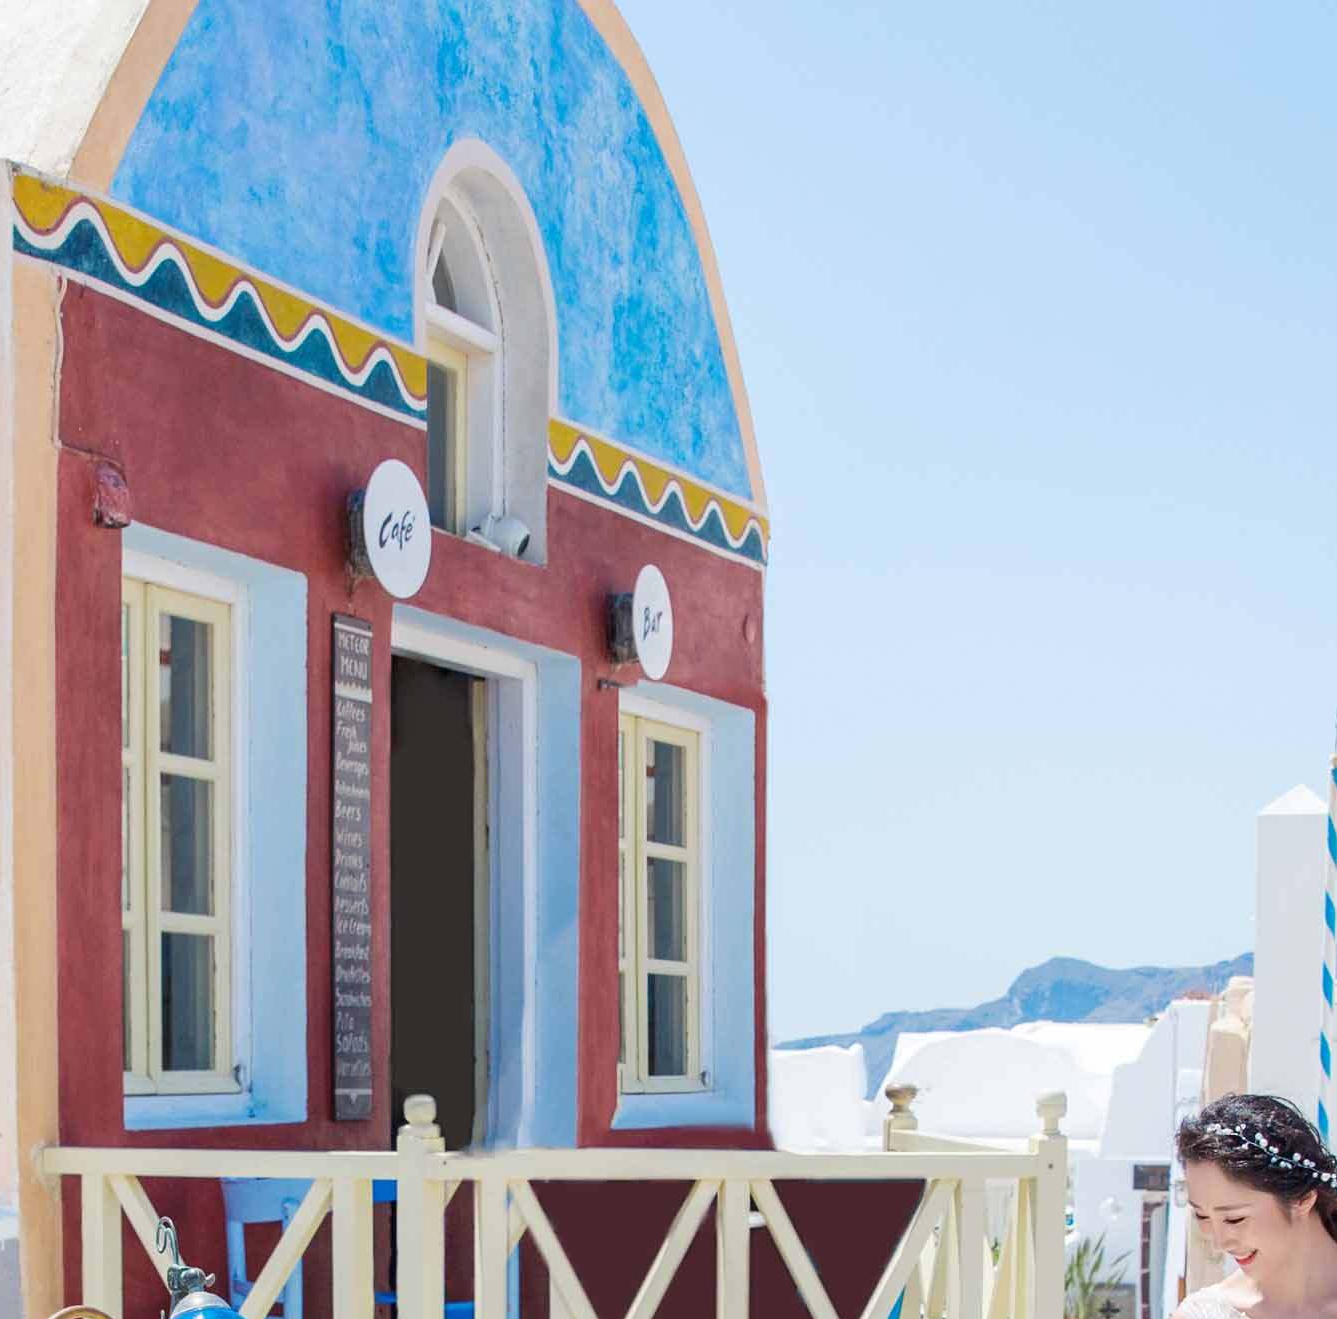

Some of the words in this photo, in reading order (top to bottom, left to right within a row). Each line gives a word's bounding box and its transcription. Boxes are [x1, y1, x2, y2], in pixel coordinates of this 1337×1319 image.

[378, 510, 416, 550] Café
[642, 606, 665, 639] Bar
[340, 655, 368, 681] MENU
